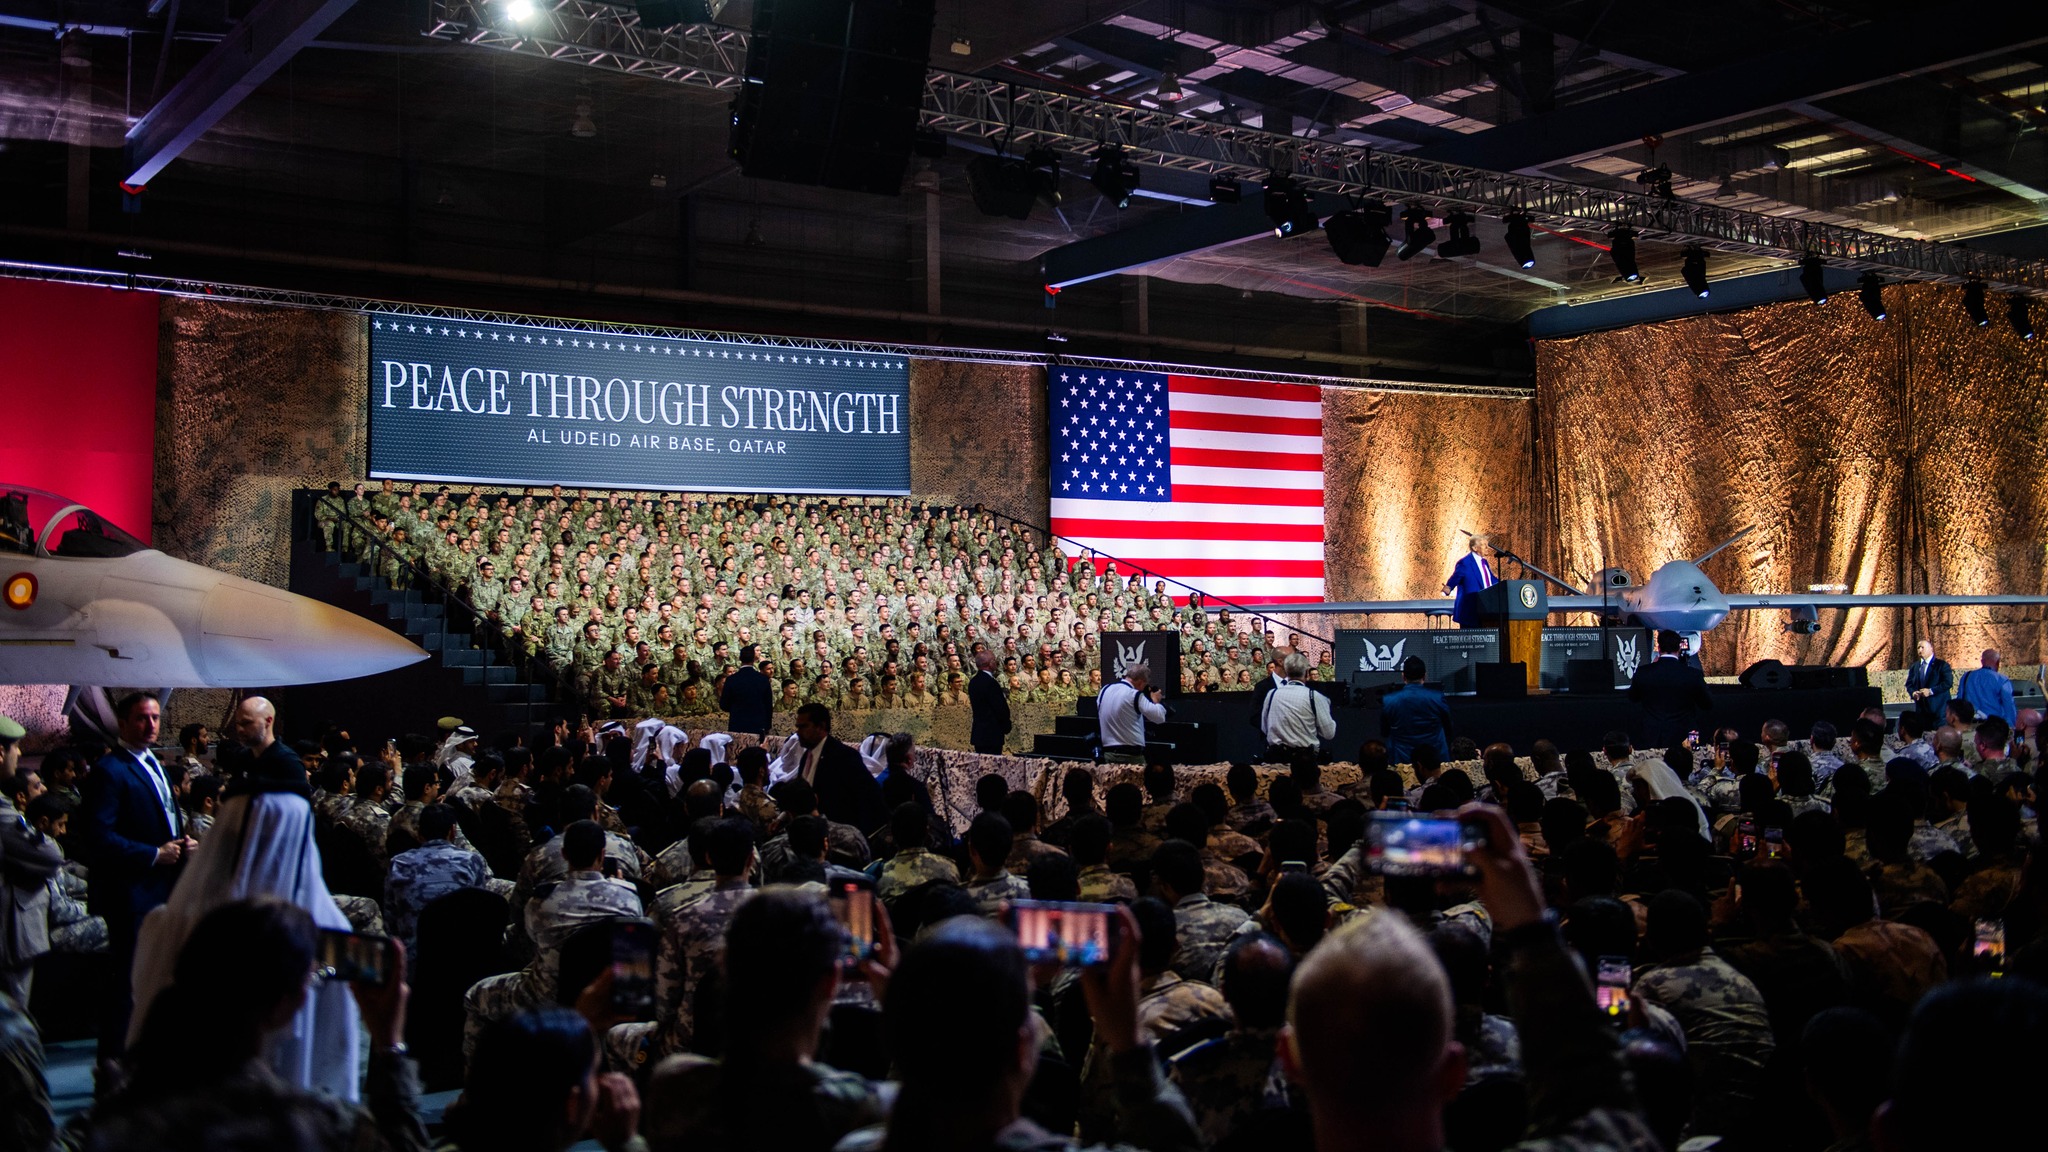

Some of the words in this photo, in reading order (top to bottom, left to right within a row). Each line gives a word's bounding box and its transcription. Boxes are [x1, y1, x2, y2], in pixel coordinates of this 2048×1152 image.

[381, 361, 511, 415] PEACE
[522, 372, 711, 427] THROUGH
[721, 386, 901, 434] STRENGTH
[527, 428, 552, 444] AL
[560, 430, 621, 447] UDEID
[629, 434, 660, 450] AIR
[668, 436, 720, 454] BASE,
[728, 438, 787, 455] QATAR
[1433, 635, 1448, 644] PEACE
[1472, 634, 1496, 643] STRENGTH
[1541, 633, 1553, 641] EACE
[1576, 633, 1599, 641] STRENGTH
